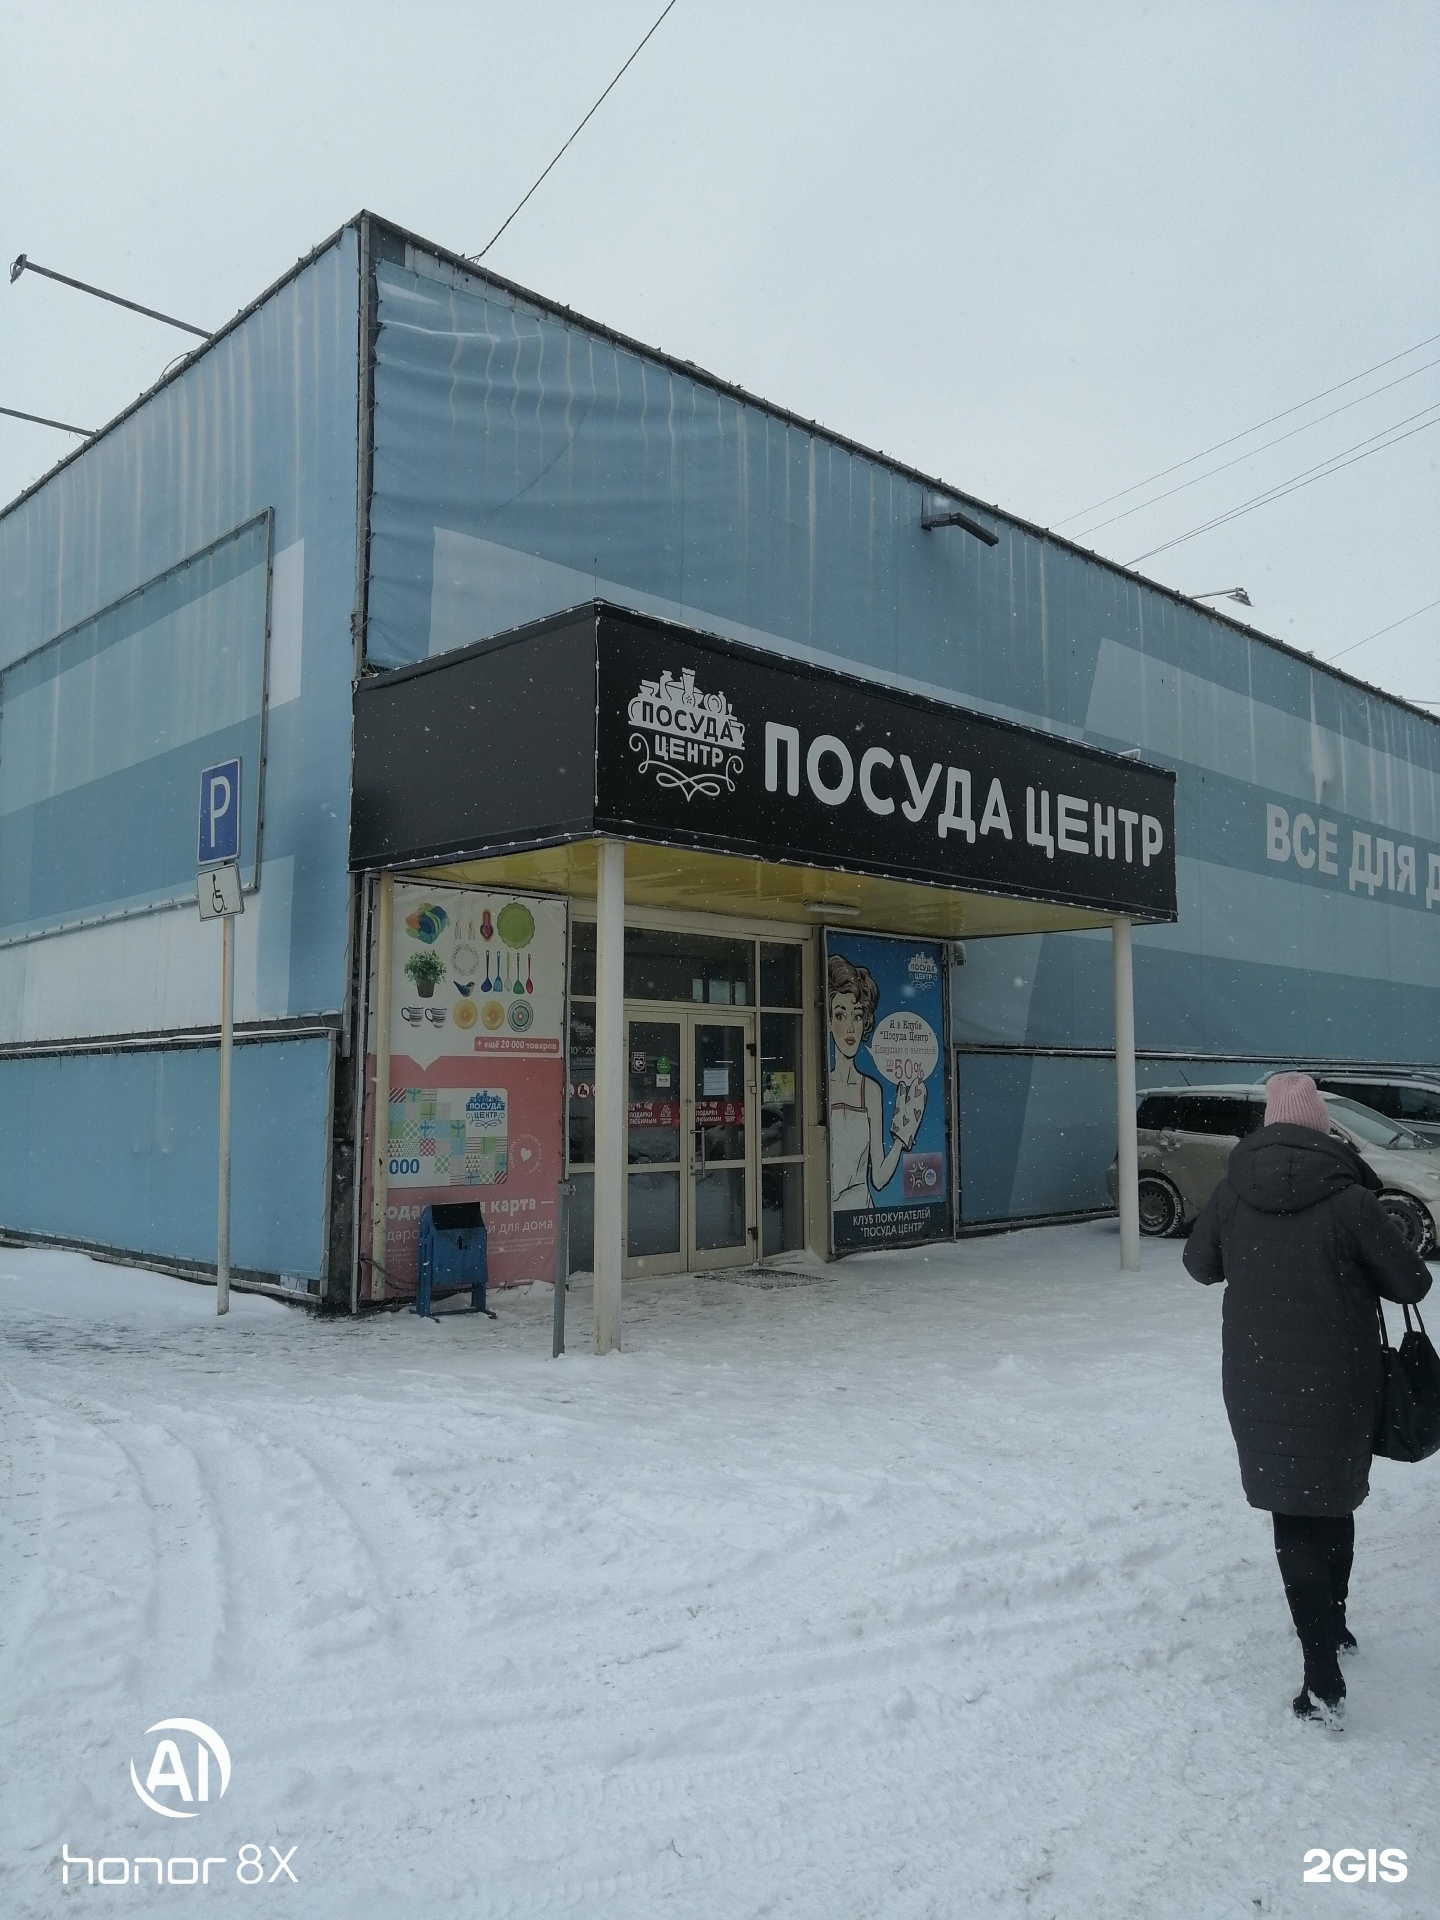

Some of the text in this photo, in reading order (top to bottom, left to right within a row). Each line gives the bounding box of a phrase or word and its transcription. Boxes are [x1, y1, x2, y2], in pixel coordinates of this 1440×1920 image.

[642, 700, 734, 742] ПОСУДА
[655, 734, 724, 767] ЦЕНТР
[764, 721, 1165, 867] ПОСУДА ЦЕНТР
[210, 775, 231, 848] P
[1266, 803, 1339, 876] ВСЕ
[1348, 829, 1417, 896] ДЛЯ
[903, 1020, 922, 1031] Клубе
[484, 1040, 500, 1050] ещё
[500, 1040, 510, 1049] 20
[511, 1040, 525, 1049] 000
[526, 1043, 557, 1051] товаров
[469, 1102, 503, 1110] ПОСУДА
[474, 1111, 498, 1120] ЦЕНТР
[490, 1198, 536, 1217] карта
[499, 1222, 520, 1235] для
[523, 1220, 553, 1233] дома
[853, 1214, 874, 1226] КЛУБ
